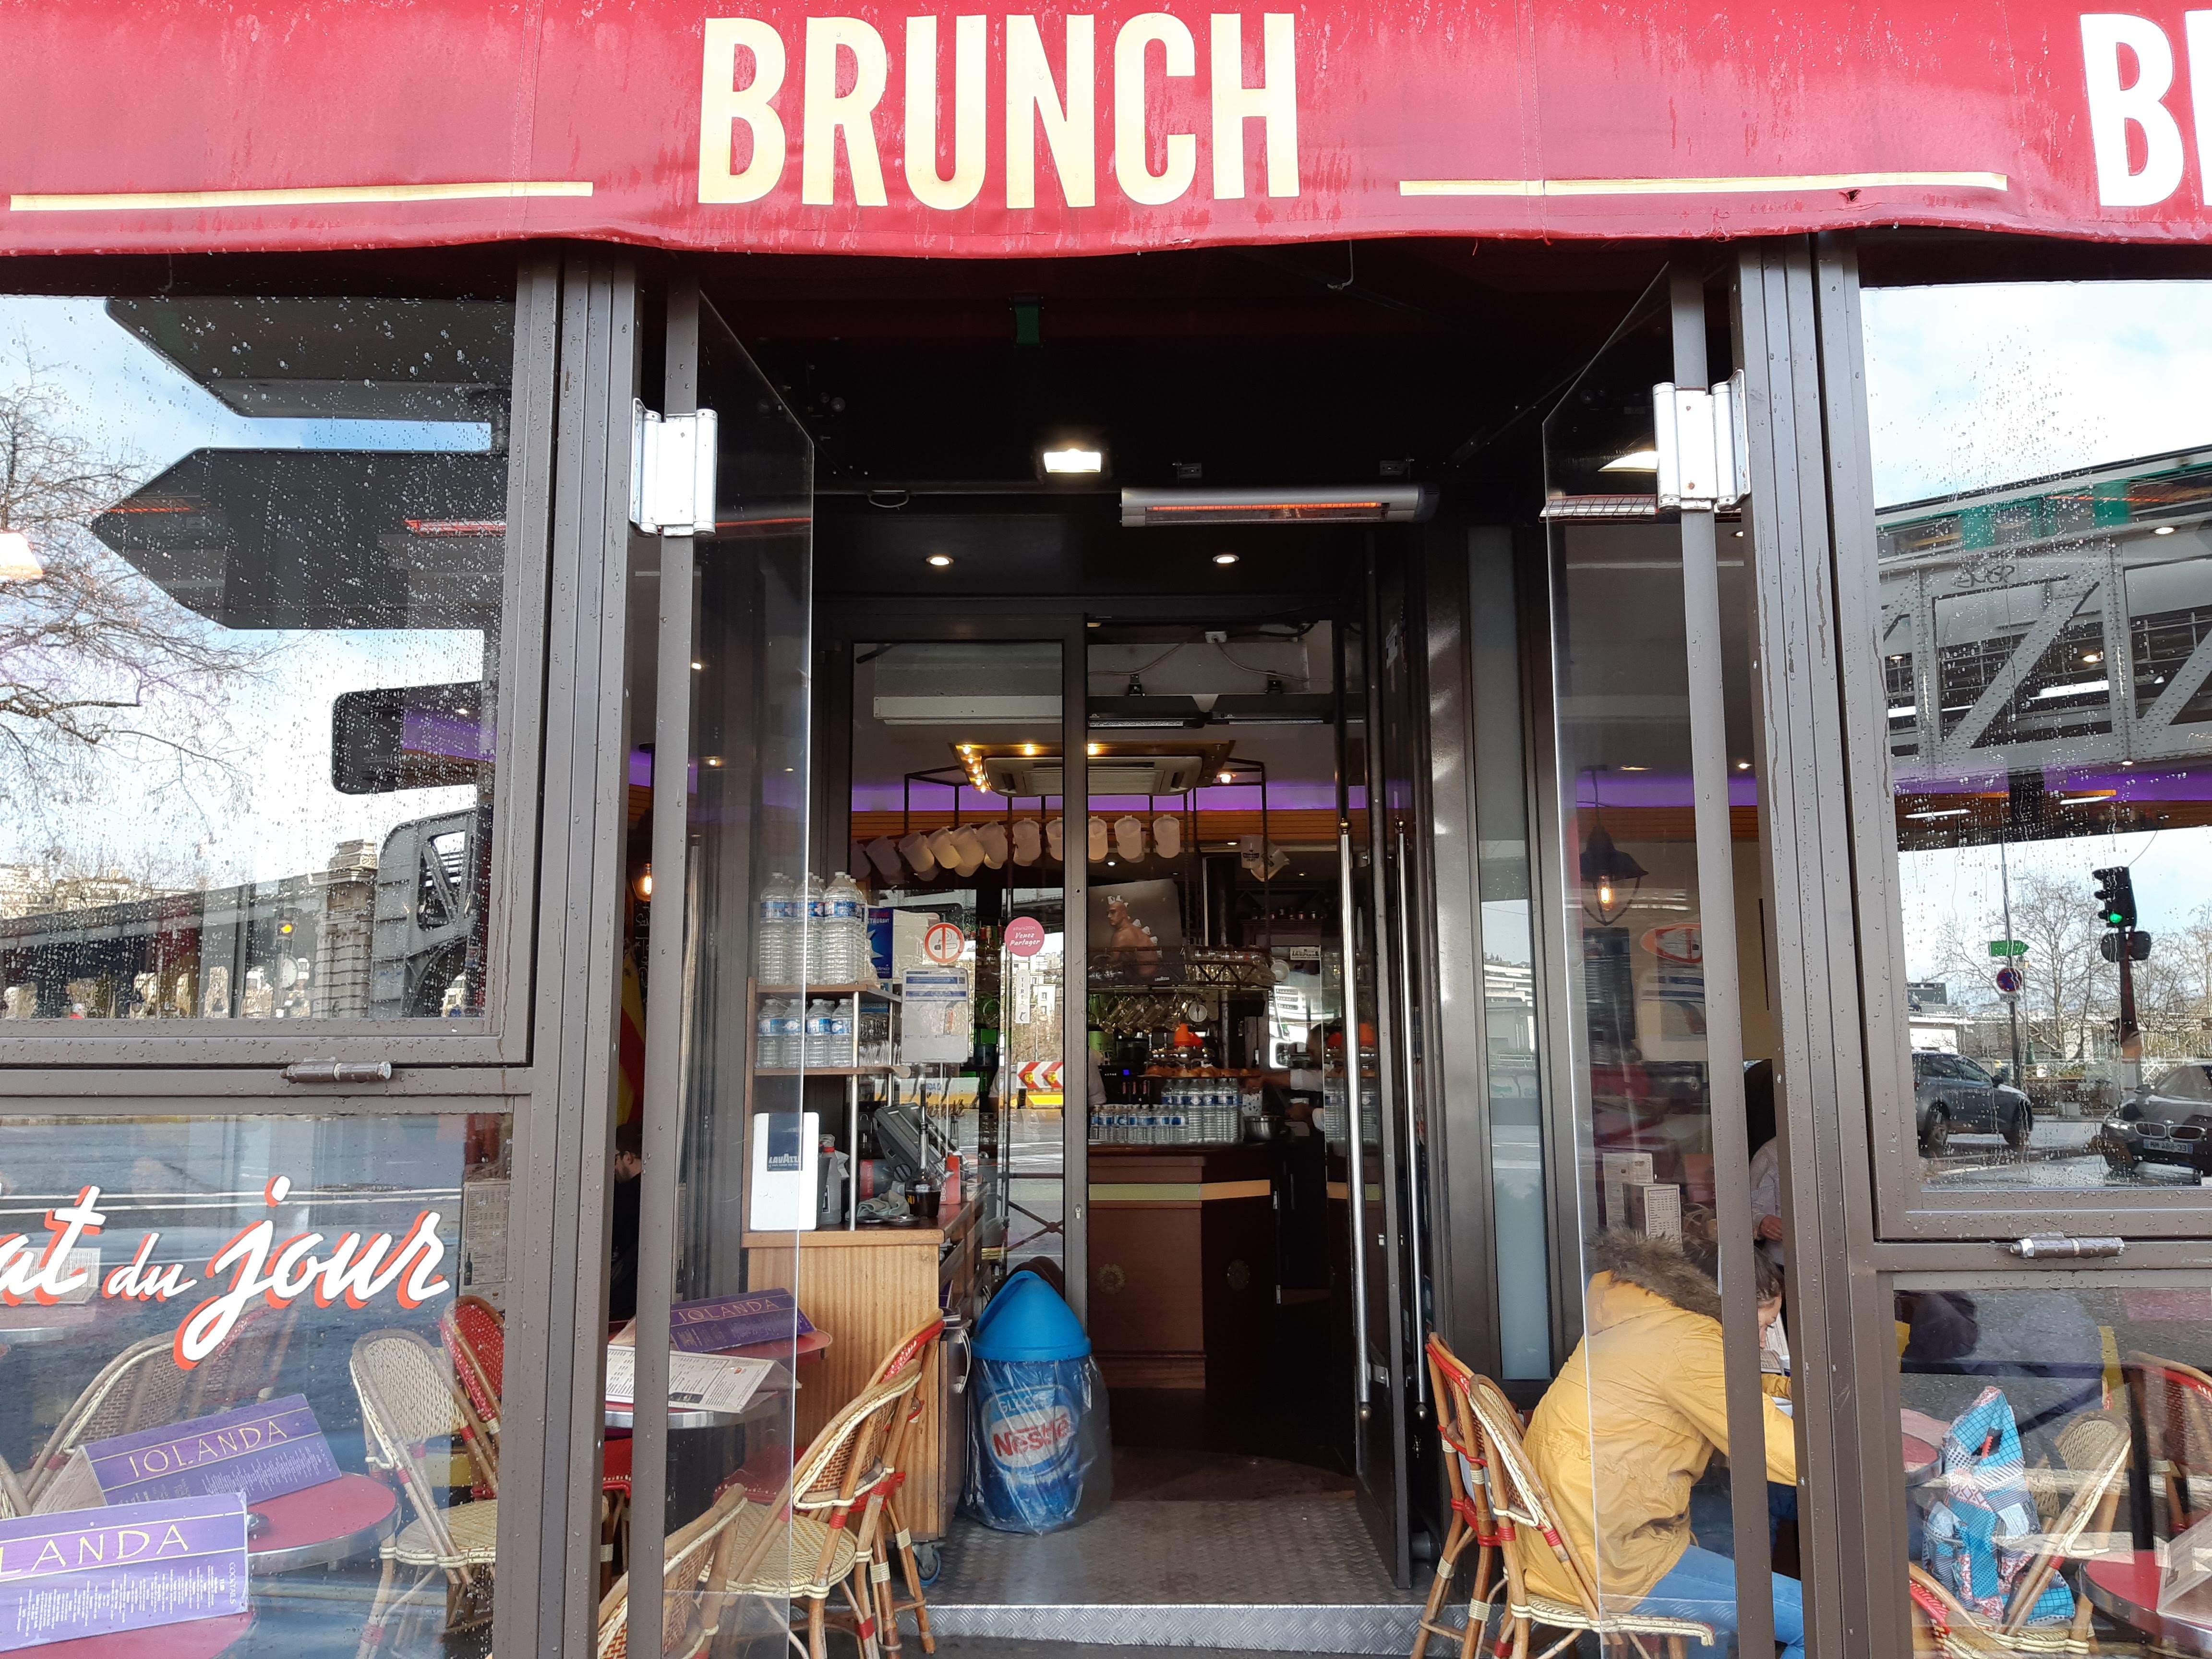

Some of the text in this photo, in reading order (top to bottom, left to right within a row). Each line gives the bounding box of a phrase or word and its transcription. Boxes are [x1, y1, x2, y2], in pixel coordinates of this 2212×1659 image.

[698, 12, 1299, 210] BRUNCH
[2080, 10, 2212, 207] B
[1010, 939, 1041, 947] Partager
[103, 1232, 197, 1301] du
[173, 1176, 450, 1370] jour
